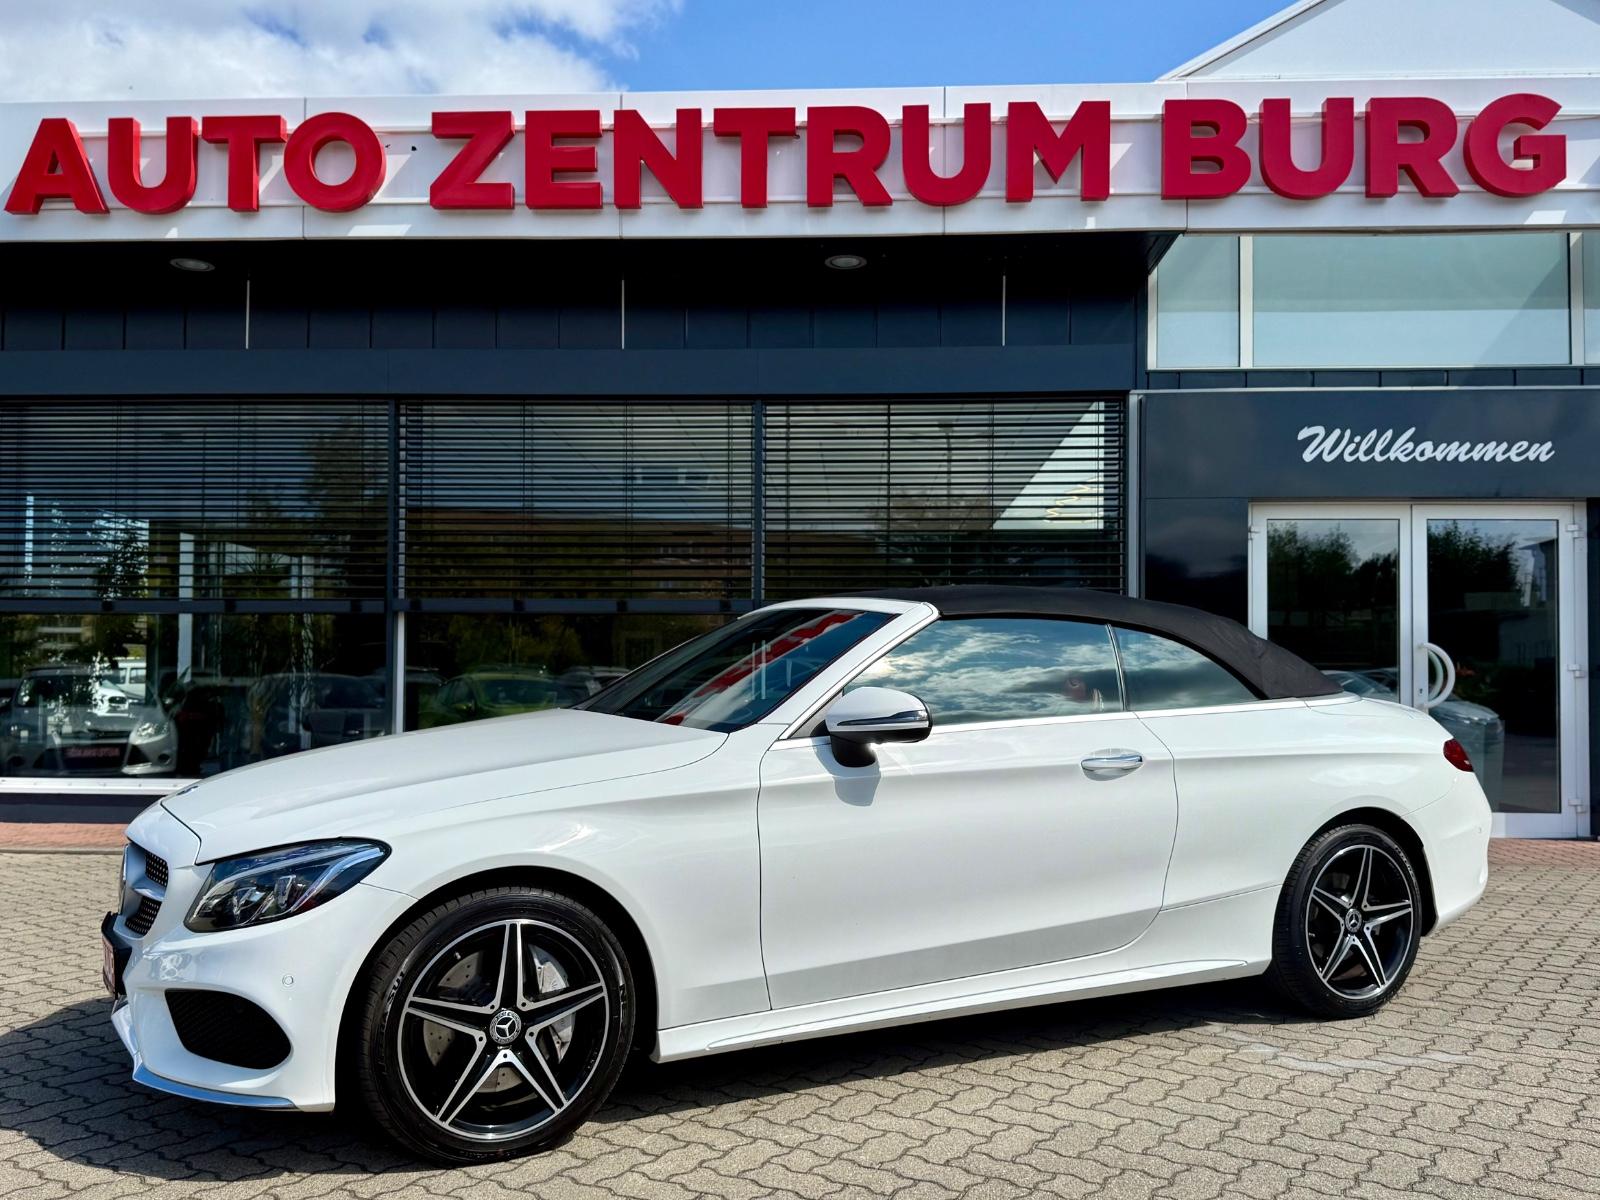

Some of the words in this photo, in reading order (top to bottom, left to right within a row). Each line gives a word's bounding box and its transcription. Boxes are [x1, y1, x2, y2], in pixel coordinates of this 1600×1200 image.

[5, 112, 386, 214] AUTO
[430, 101, 1110, 210] ZENTRUM
[1162, 94, 1566, 200] BURG
[1297, 425, 1555, 463] Willkommen
